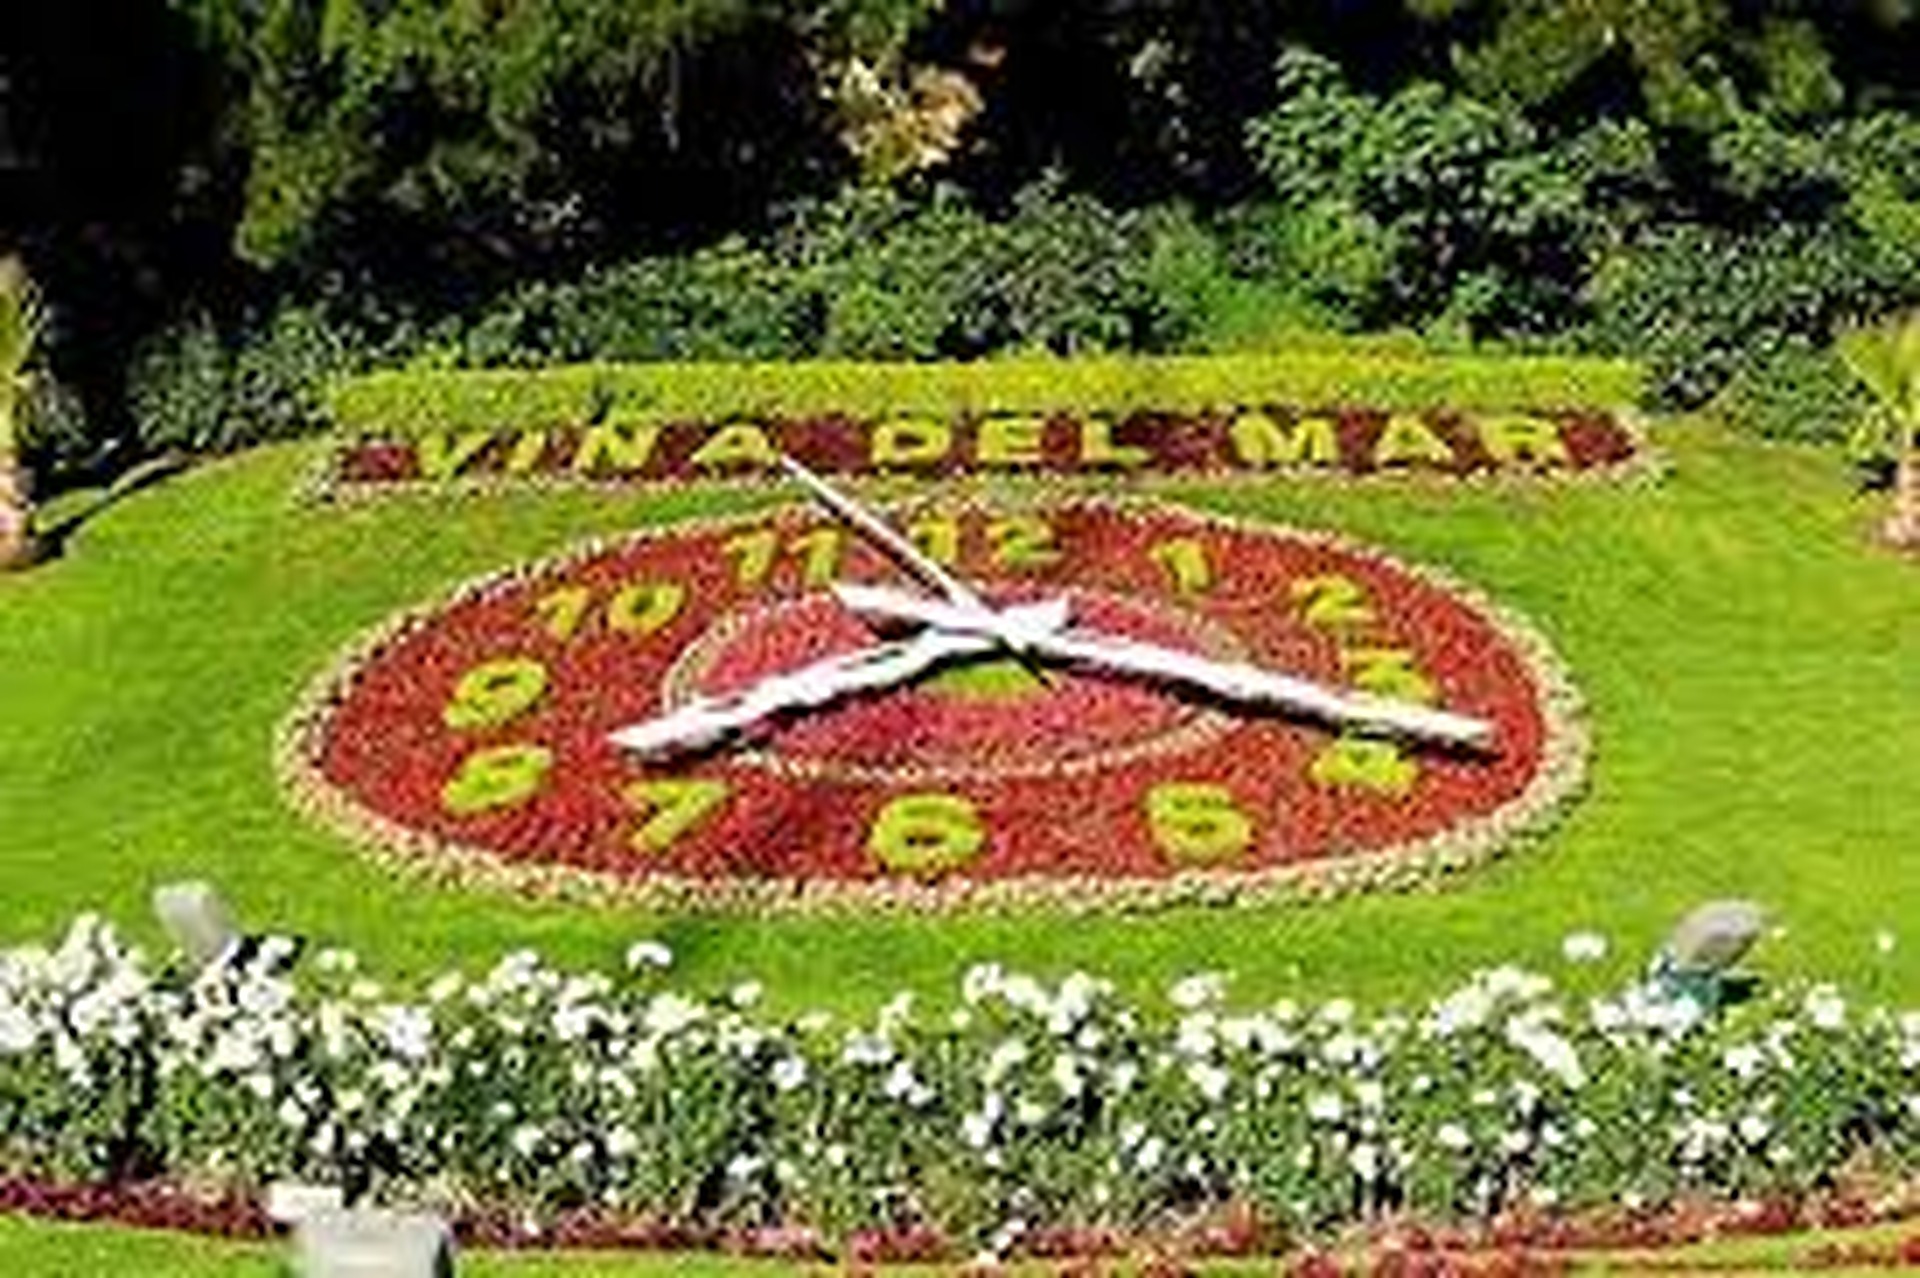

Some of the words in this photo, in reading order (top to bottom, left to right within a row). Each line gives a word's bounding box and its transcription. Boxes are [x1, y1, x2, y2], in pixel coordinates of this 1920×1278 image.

[870, 415, 1147, 466] DEL
[1230, 414, 1568, 465] MAR
[722, 530, 840, 588] 11
[908, 513, 1060, 566] 12
[1148, 538, 1210, 592] 1
[536, 582, 684, 642] 10
[1290, 574, 1375, 626] 2
[622, 776, 730, 852] 7
